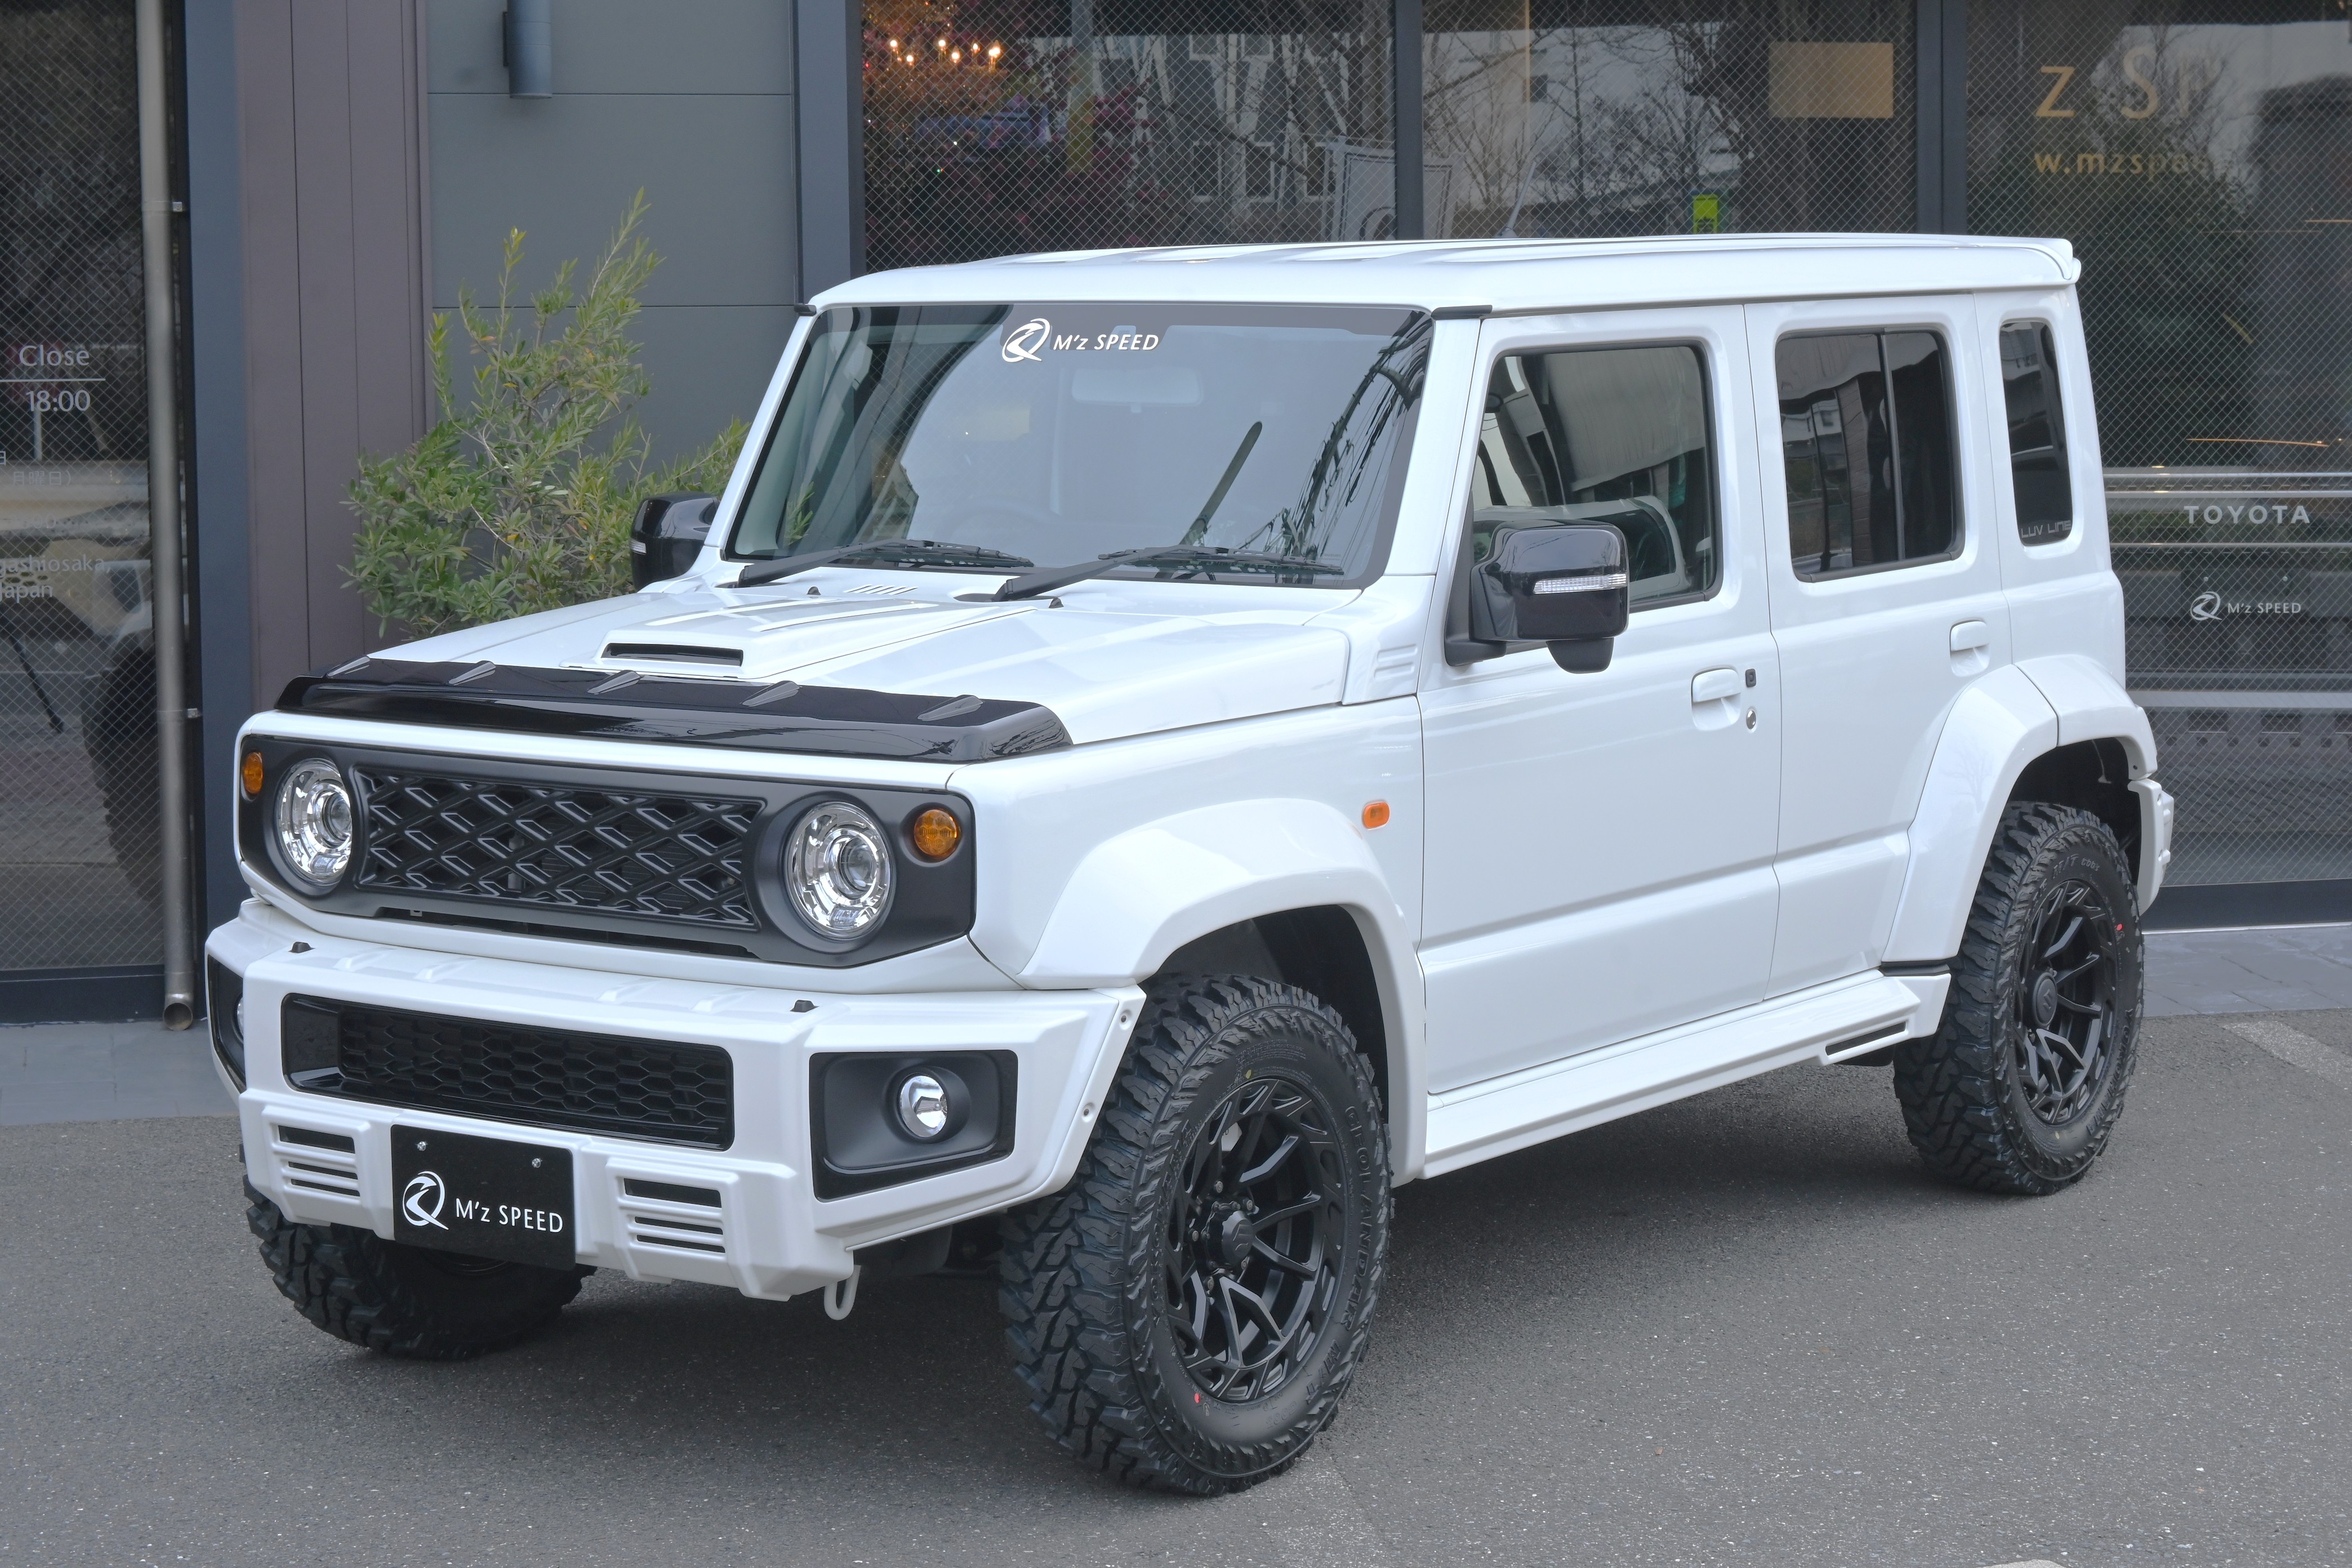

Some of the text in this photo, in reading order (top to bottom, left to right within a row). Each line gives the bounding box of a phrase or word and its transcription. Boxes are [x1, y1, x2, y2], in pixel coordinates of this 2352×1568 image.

[1053, 333, 1159, 351] M'z SPEED
[19, 344, 90, 367] Close
[26, 389, 91, 412] 18:00
[2184, 505, 2310, 525] TOYOTA
[2021, 524, 2043, 538] LUV
[2227, 602, 2302, 614] M'z SPEED
[455, 1198, 563, 1233] M'z SPEED
[1340, 1105, 1373, 1333] GEOLANDAR
